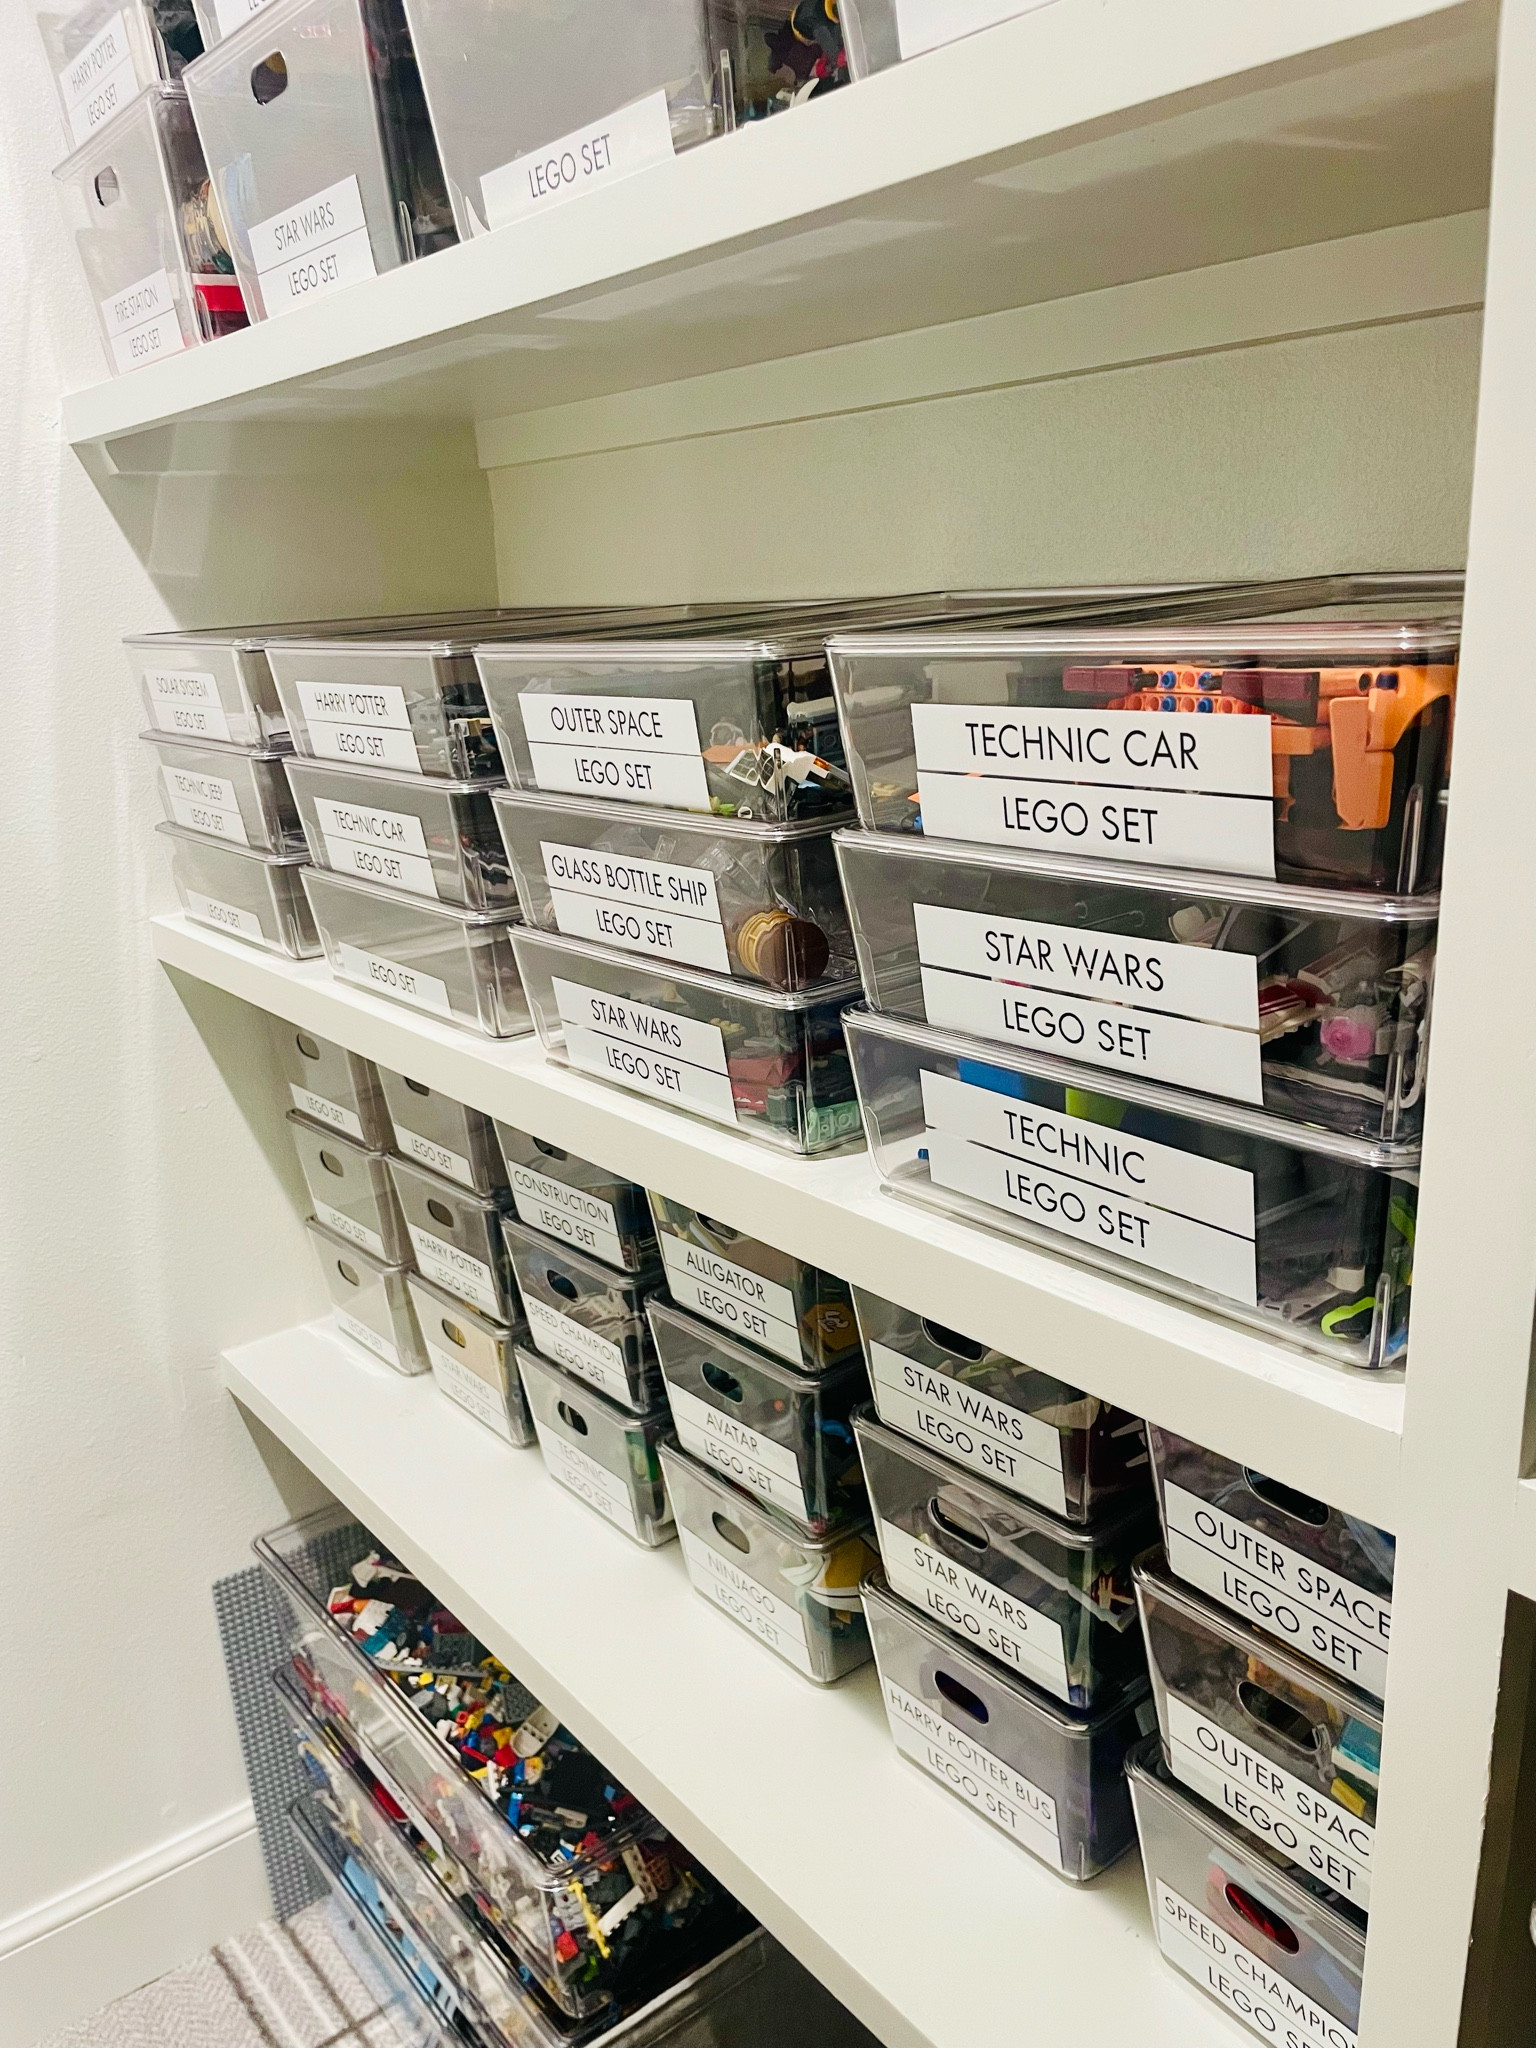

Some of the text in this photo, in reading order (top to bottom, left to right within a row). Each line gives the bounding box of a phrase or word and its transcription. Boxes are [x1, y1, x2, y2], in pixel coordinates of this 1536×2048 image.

[72, 34, 117, 92] HARRY POTTER
[88, 83, 118, 126] LEGO SET
[528, 133, 611, 199] LEGO SET
[274, 201, 334, 251] STAR WARS
[288, 255, 339, 296] LEGO SET
[115, 285, 159, 322] FIRE STATION
[131, 328, 161, 358] LEGO SET
[156, 677, 209, 697] SOLAR SYSTEM
[315, 692, 387, 716] HARRY POTTER
[174, 710, 206, 730] LEGO SET
[551, 706, 664, 738] OUTER SPACE
[337, 733, 384, 757] LEGO SET
[964, 722, 1199, 771] TECHNIC CAR
[175, 775, 223, 801] TECHNIC JEEP
[575, 759, 652, 790] LEGO SET
[191, 808, 224, 831] LEGO SET
[333, 810, 405, 842] TECHNIC CAR
[1003, 796, 1158, 845] LEGO SET
[354, 850, 402, 880] LEGO SET
[551, 854, 707, 907] GLASS BOTTLE SHIP
[205, 903, 241, 928] LEGO SET
[596, 908, 673, 948] LEGO SET
[368, 961, 416, 995] LEGO SET
[985, 930, 1164, 992] STAR WARS
[591, 999, 682, 1048] STAR WARS
[1003, 999, 1152, 1061] LEGO SET
[605, 1046, 681, 1092] LEGO SET
[307, 1097, 344, 1125] LEGO SET
[410, 1138, 453, 1172] LEGO SET
[1003, 1109, 1146, 1185] TECHNIC
[514, 1170, 609, 1224] CONSTRUCTION
[1005, 1170, 1150, 1250] LEGO SET
[331, 1212, 366, 1243] LEGO SET
[539, 1209, 596, 1247] LEGO SET
[437, 1267, 478, 1301] LEGO SET
[686, 1250, 765, 1303] ALLIGATOR
[529, 1302, 622, 1367] SPEED CHAMPION
[696, 1287, 767, 1338] LEGO SET
[554, 1342, 607, 1385] LEGO SET
[903, 1366, 1023, 1441] STAR WARS
[706, 1412, 759, 1455] AVATAR
[918, 1409, 1018, 1478] LEGO SET
[703, 1439, 772, 1494] LEGO SET
[564, 1469, 613, 1516] LEGO SET
[708, 1553, 775, 1613] NINJAGO
[913, 1546, 1029, 1633] STAR WARS
[1194, 1510, 1391, 1640] OUTER SPACE
[715, 1583, 779, 1645] LEGO SET
[928, 1588, 1022, 1664] LEGO SET
[1223, 1571, 1363, 1672] LEGO SET
[891, 1687, 1052, 1820] HARRY POTTER BUS
[927, 1747, 1019, 1828] LEGO SET
[1197, 1726, 1375, 1857] OUTER SPAC
[1223, 1783, 1356, 1891] LEGO SET
[1165, 1897, 1355, 2048] SPEED CHAMPIO
[1208, 1966, 1275, 2032] LEGO
